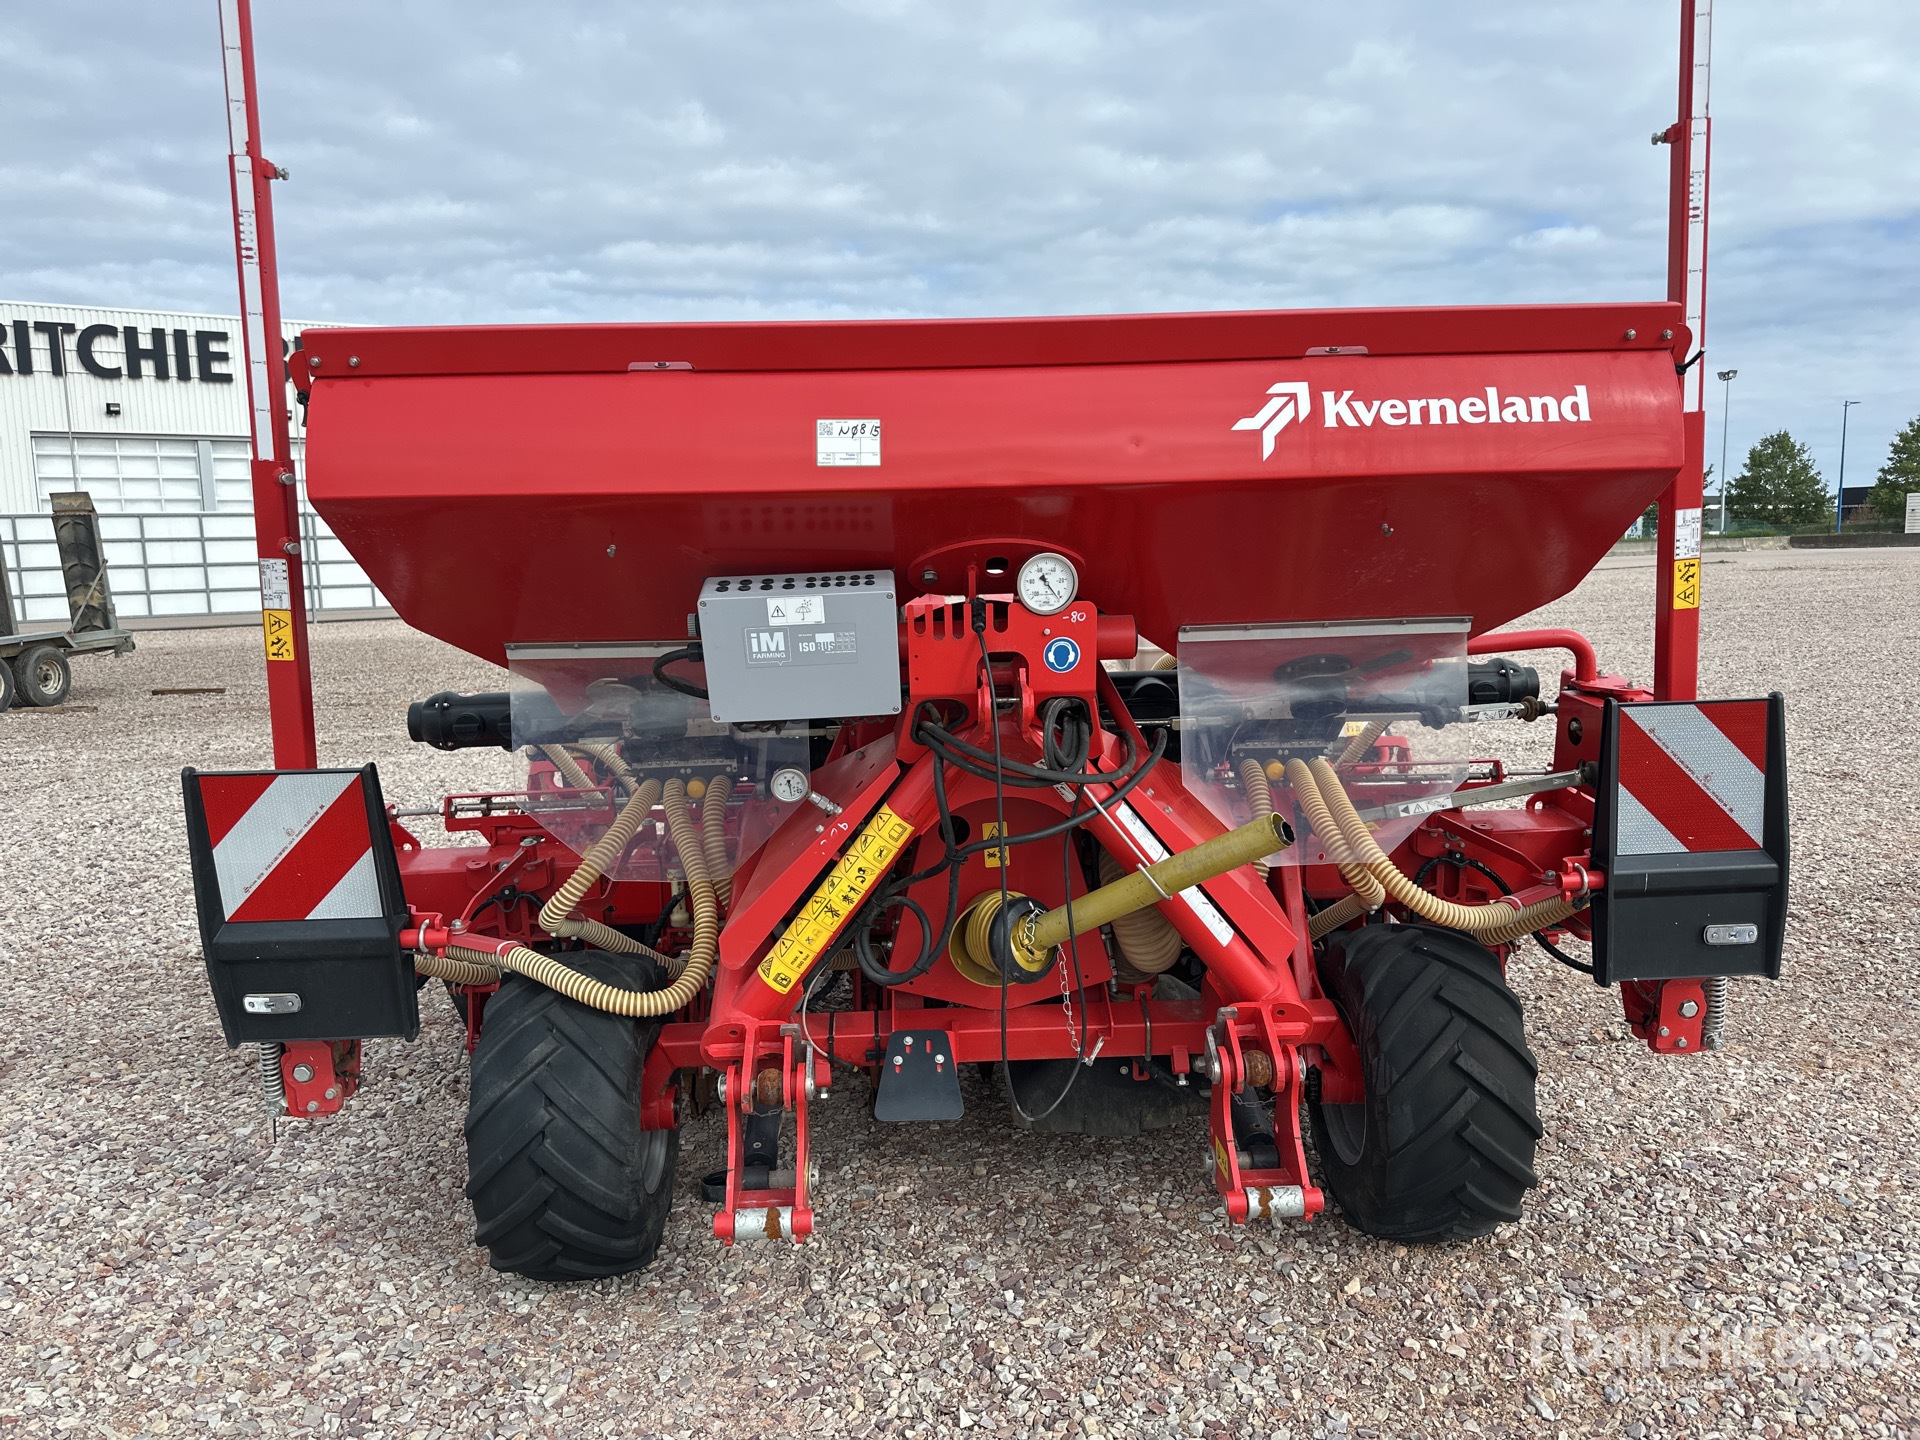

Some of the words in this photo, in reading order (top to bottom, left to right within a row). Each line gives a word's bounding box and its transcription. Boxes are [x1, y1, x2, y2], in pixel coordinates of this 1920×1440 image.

[1321, 385, 1592, 427] Kverneland
[1062, 611, 1086, 623] -80
[750, 631, 785, 652] iM
